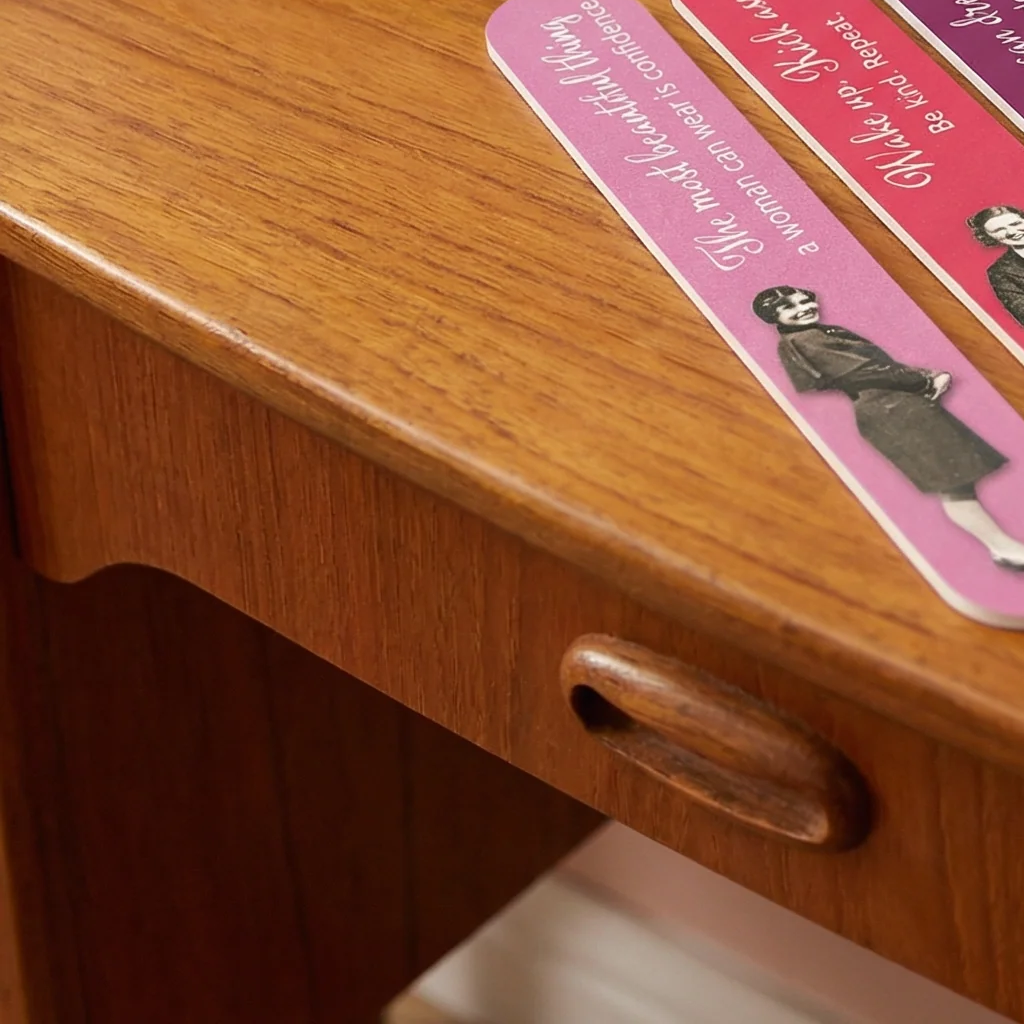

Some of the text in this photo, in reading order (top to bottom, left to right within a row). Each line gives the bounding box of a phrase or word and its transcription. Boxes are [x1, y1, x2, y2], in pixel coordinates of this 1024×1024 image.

[750, 23, 839, 83] Kick
[826, 11, 955, 134] Be kind. Repeat.
[653, 82, 680, 101] is
[668, 101, 716, 140] wear
[540, 14, 764, 271] The most beautiful thing
[707, 140, 744, 173] can
[850, 112, 935, 189] Wake
[736, 174, 804, 241] woman
[798, 241, 819, 255] a
